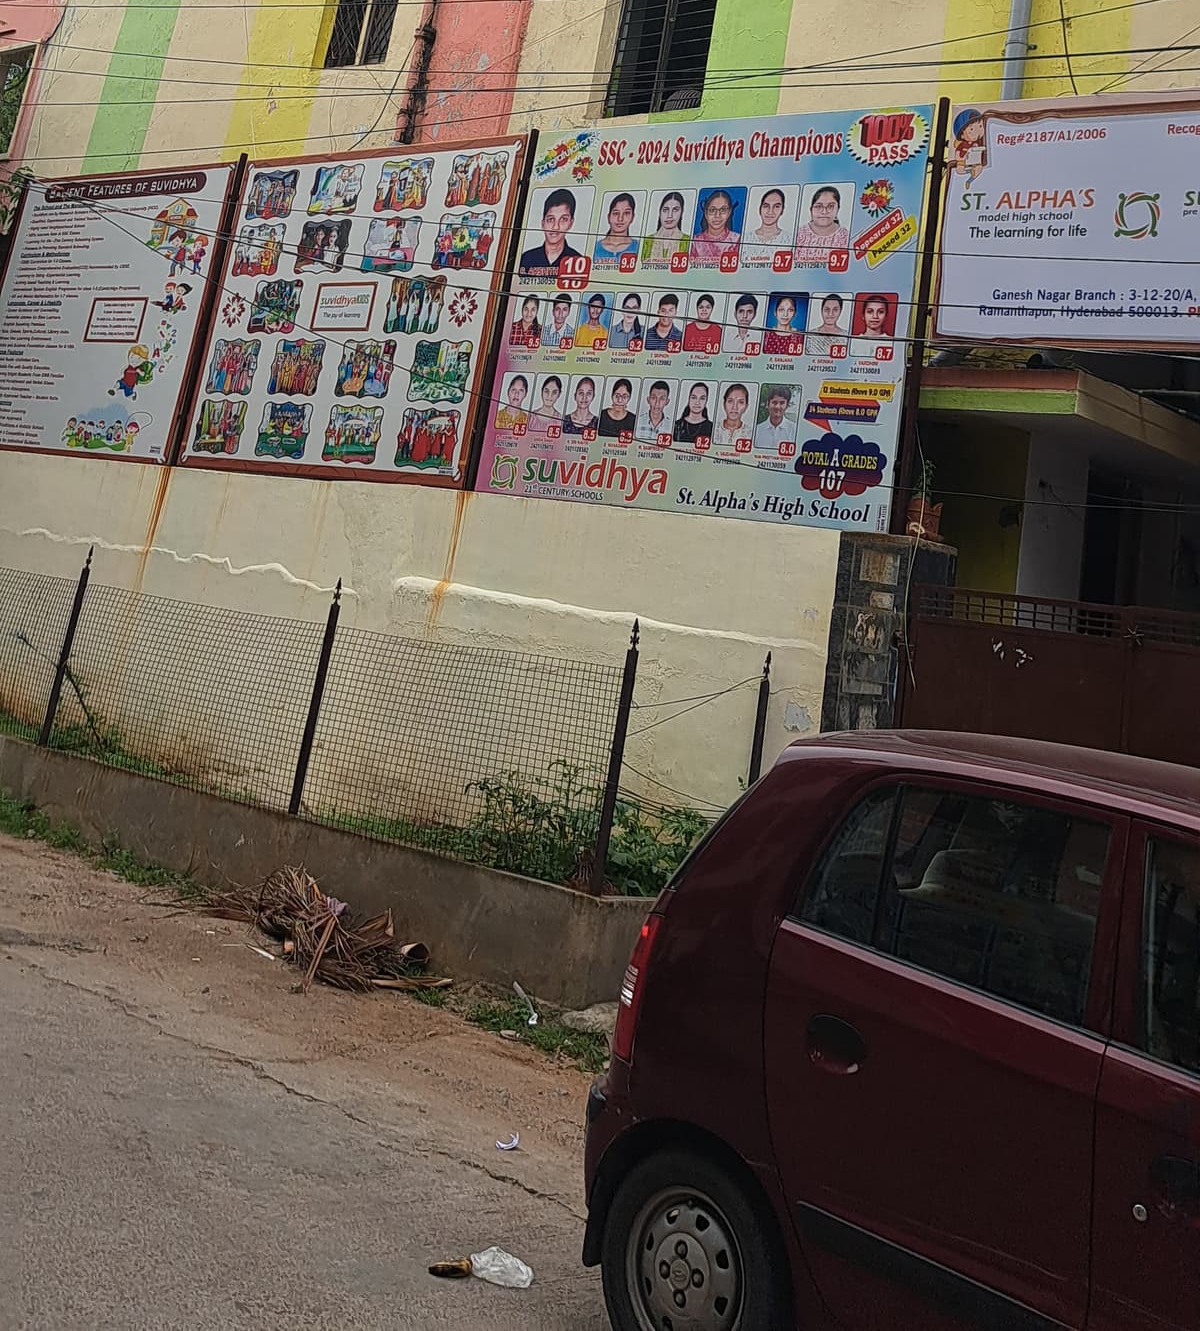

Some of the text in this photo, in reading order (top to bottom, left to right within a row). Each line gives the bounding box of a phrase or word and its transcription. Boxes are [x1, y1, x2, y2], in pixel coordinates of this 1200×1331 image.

[859, 113, 915, 148] 100%
[997, 128, 1107, 146] Reg#2187/A1/2006
[598, 140, 627, 166] SSC
[637, 139, 671, 165] 2024
[673, 134, 744, 166] Suvidhya
[750, 128, 843, 161] Champions
[869, 145, 909, 161] PASS
[88, 183, 133, 197] FEATURES
[135, 183, 148, 194] OF
[151, 177, 198, 193] SUVIDHYA
[960, 188, 1095, 210] ST. ALPHA'S
[890, 213, 902, 225] 32
[978, 211, 1073, 223] model high school
[969, 224, 1088, 239] The learning for life
[871, 223, 912, 258] Passed 32
[564, 256, 587, 273] 10
[621, 256, 635, 269] 9.8
[672, 256, 687, 269] 9.8
[721, 256, 737, 268] 9.8
[774, 256, 791, 268] 9.7
[830, 254, 847, 268] 9.7
[992, 289, 1033, 301] Ganesh
[1037, 289, 1071, 304] Nagar
[1074, 289, 1116, 301] Branch
[1128, 289, 1198, 303] 3-12-20/A,
[1187, 306, 1200, 317] P
[528, 338, 540, 348] 9.5
[560, 339, 572, 349] 9.3
[594, 340, 606, 350] 9.2
[630, 340, 641, 351] 9.2
[667, 341, 680, 352] 9.2
[705, 343, 719, 353] 9.0
[746, 343, 760, 354] 8.8
[788, 343, 802, 354] 8.8
[832, 346, 847, 357] 8.8
[876, 348, 892, 359] 8.7
[851, 388, 867, 396] Above
[869, 388, 878, 396] 9.0
[513, 424, 526, 435] 8.5
[547, 427, 560, 437] 8.5
[583, 430, 596, 440] 8.5
[658, 435, 671, 446] 8.2
[696, 437, 709, 448] 8.2
[737, 441, 750, 452] 8.2
[780, 444, 794, 455] 8.0
[802, 448, 878, 470] TOTAL A GRADES
[522, 456, 668, 502] suvidhya
[819, 469, 845, 492] 107
[538, 487, 569, 497] CENTURY
[570, 490, 603, 501] SCHOOLS
[676, 487, 695, 505] St.
[699, 490, 759, 513] Alpha's
[763, 495, 804, 520] High
[808, 500, 870, 522] School
